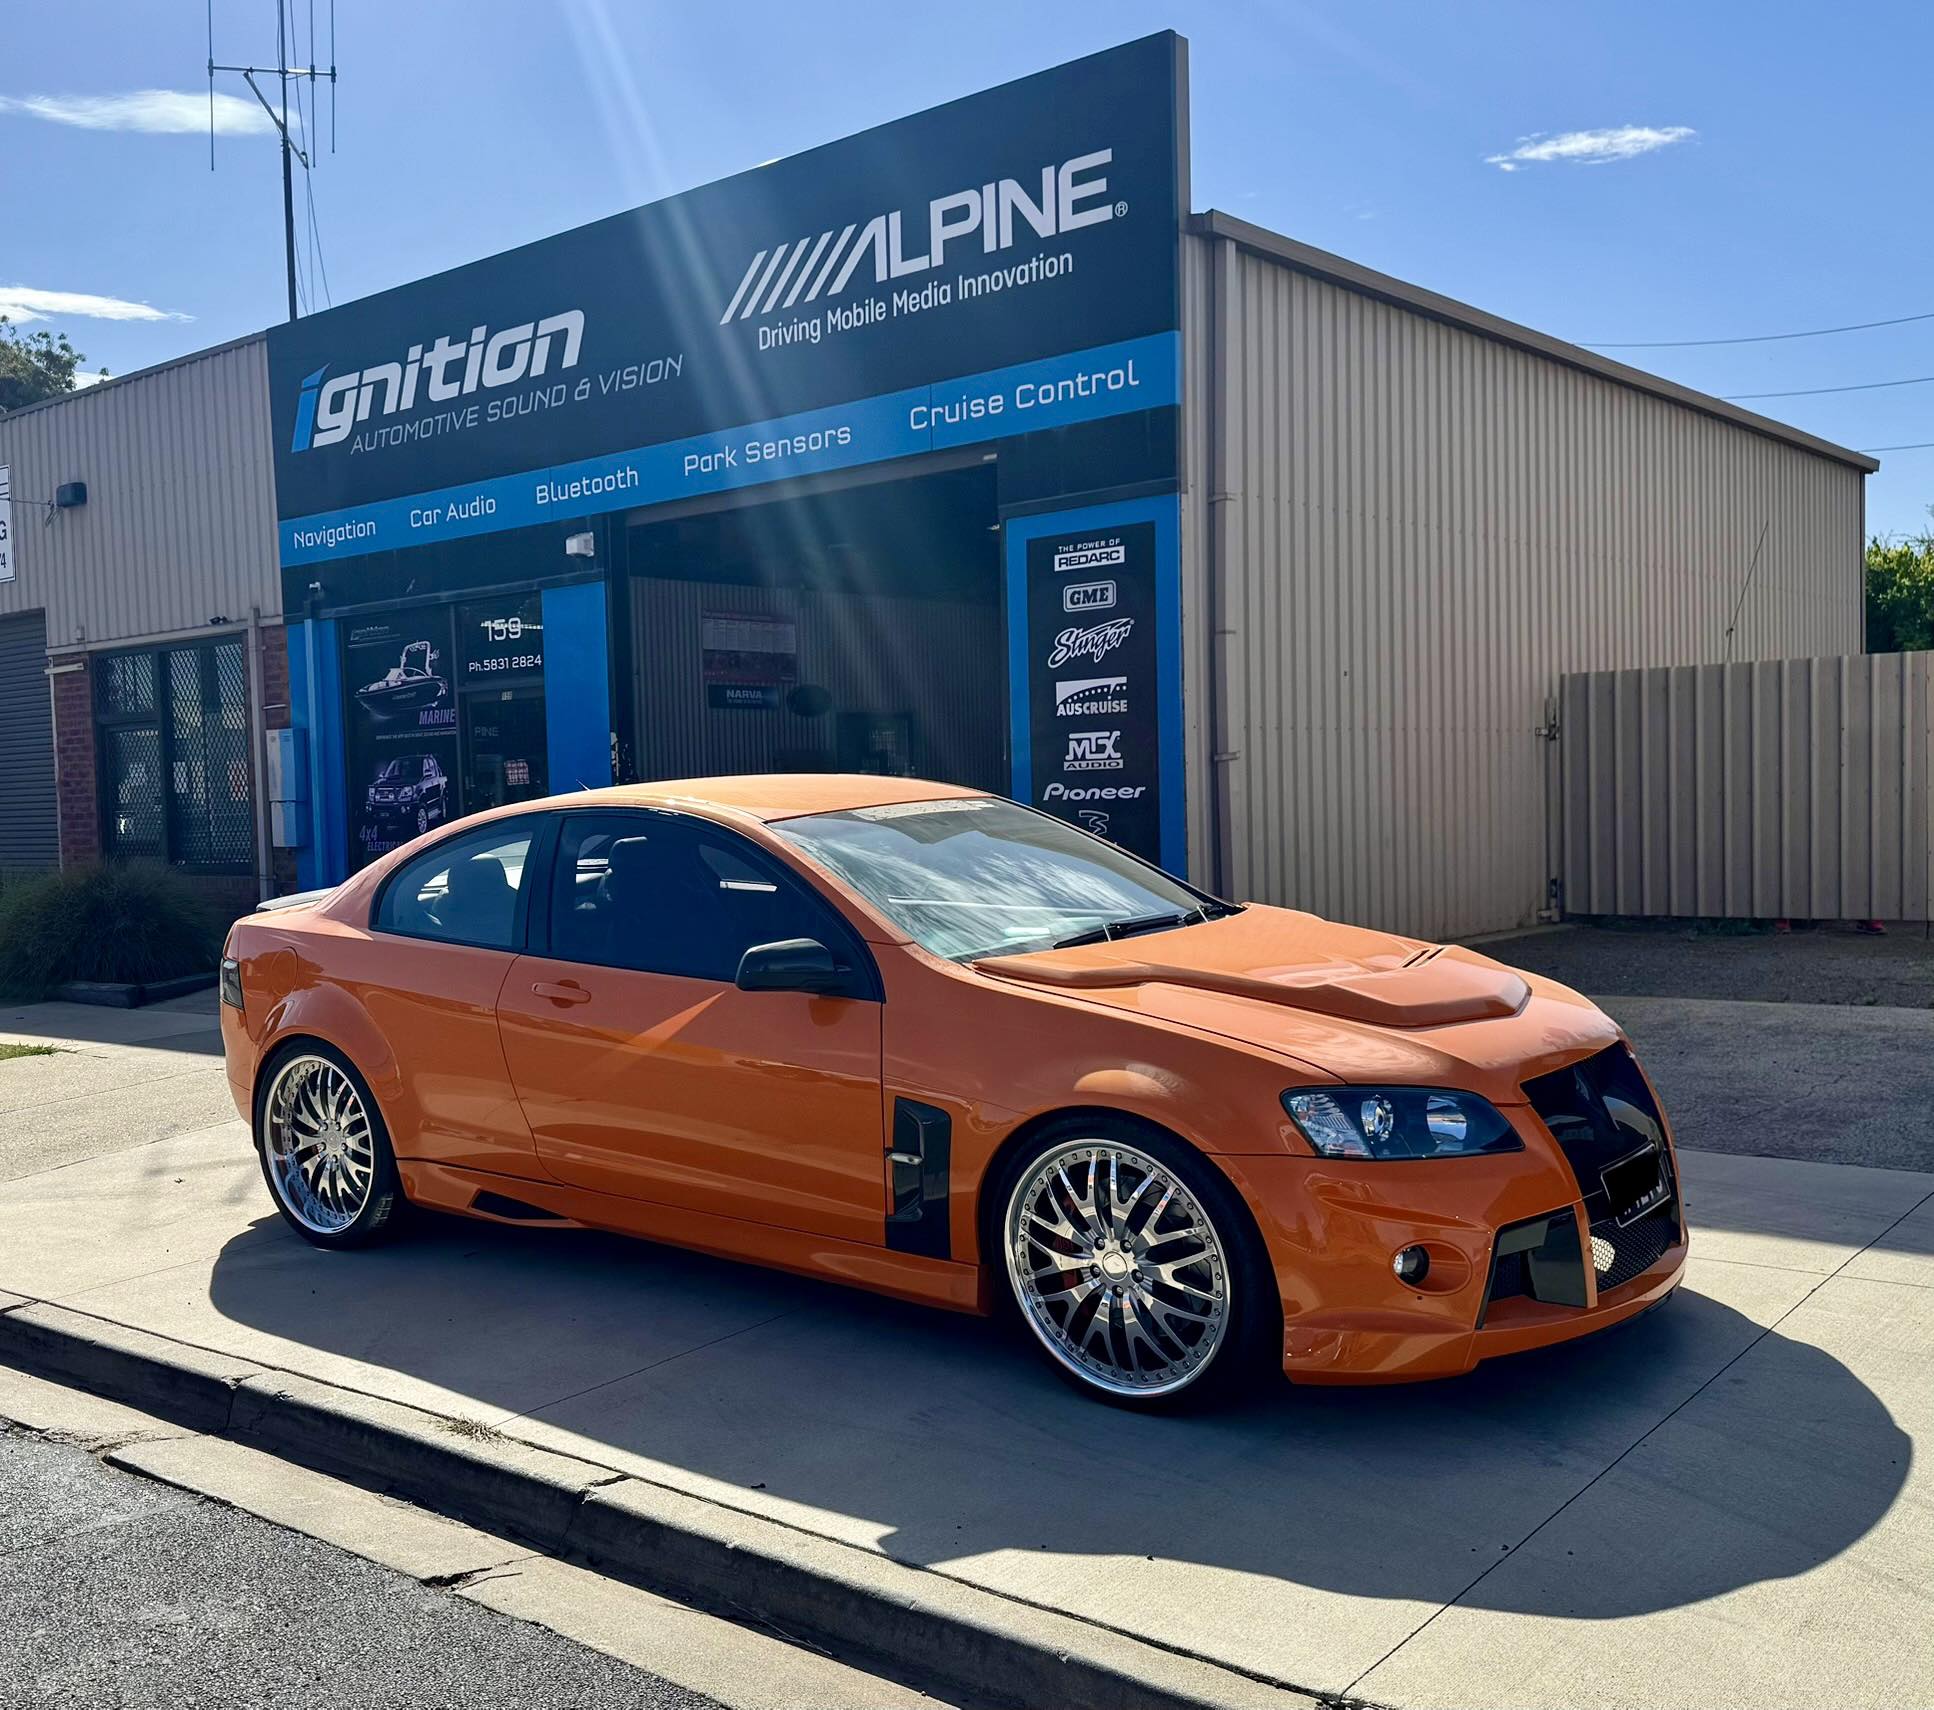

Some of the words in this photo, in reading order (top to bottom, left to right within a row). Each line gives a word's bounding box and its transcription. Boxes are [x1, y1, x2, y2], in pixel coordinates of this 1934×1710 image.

[828, 147, 1113, 296] ALPINE
[758, 314, 821, 351] Driving
[826, 301, 887, 334] Mobile
[893, 283, 951, 312] Media
[958, 252, 1073, 300] Innovation
[291, 309, 585, 453] ignition
[350, 405, 479, 456] AUTOMOTIVE
[486, 383, 566, 422] SOUND
[574, 378, 590, 401] &
[599, 354, 684, 397] VISION
[293, 520, 377, 549] Navigation
[410, 507, 442, 528] Car
[445, 496, 497, 521] Audio
[536, 466, 639, 504] Bluetooth
[683, 445, 738, 477] Park
[745, 425, 852, 464] Sensors
[910, 393, 1004, 431] Cruise
[1015, 359, 1140, 410] Control
[1058, 545, 1074, 553] THE
[1077, 540, 1106, 550] POWER
[1109, 538, 1121, 546] OF
[1058, 550, 1120, 568] REDARC
[1069, 587, 1109, 606] GME
[484, 617, 521, 641] 159
[1048, 617, 1131, 669] Stinger
[511, 654, 542, 668] 2824
[726, 689, 762, 699] NARVA
[419, 708, 456, 725] MARINE
[1056, 699, 1128, 717] AUSCRUISE
[1065, 730, 1121, 760] MTX
[1066, 761, 1120, 770] AUDIO
[1043, 782, 1146, 801] Pioneer
[367, 841, 404, 851] ELECTRIC
